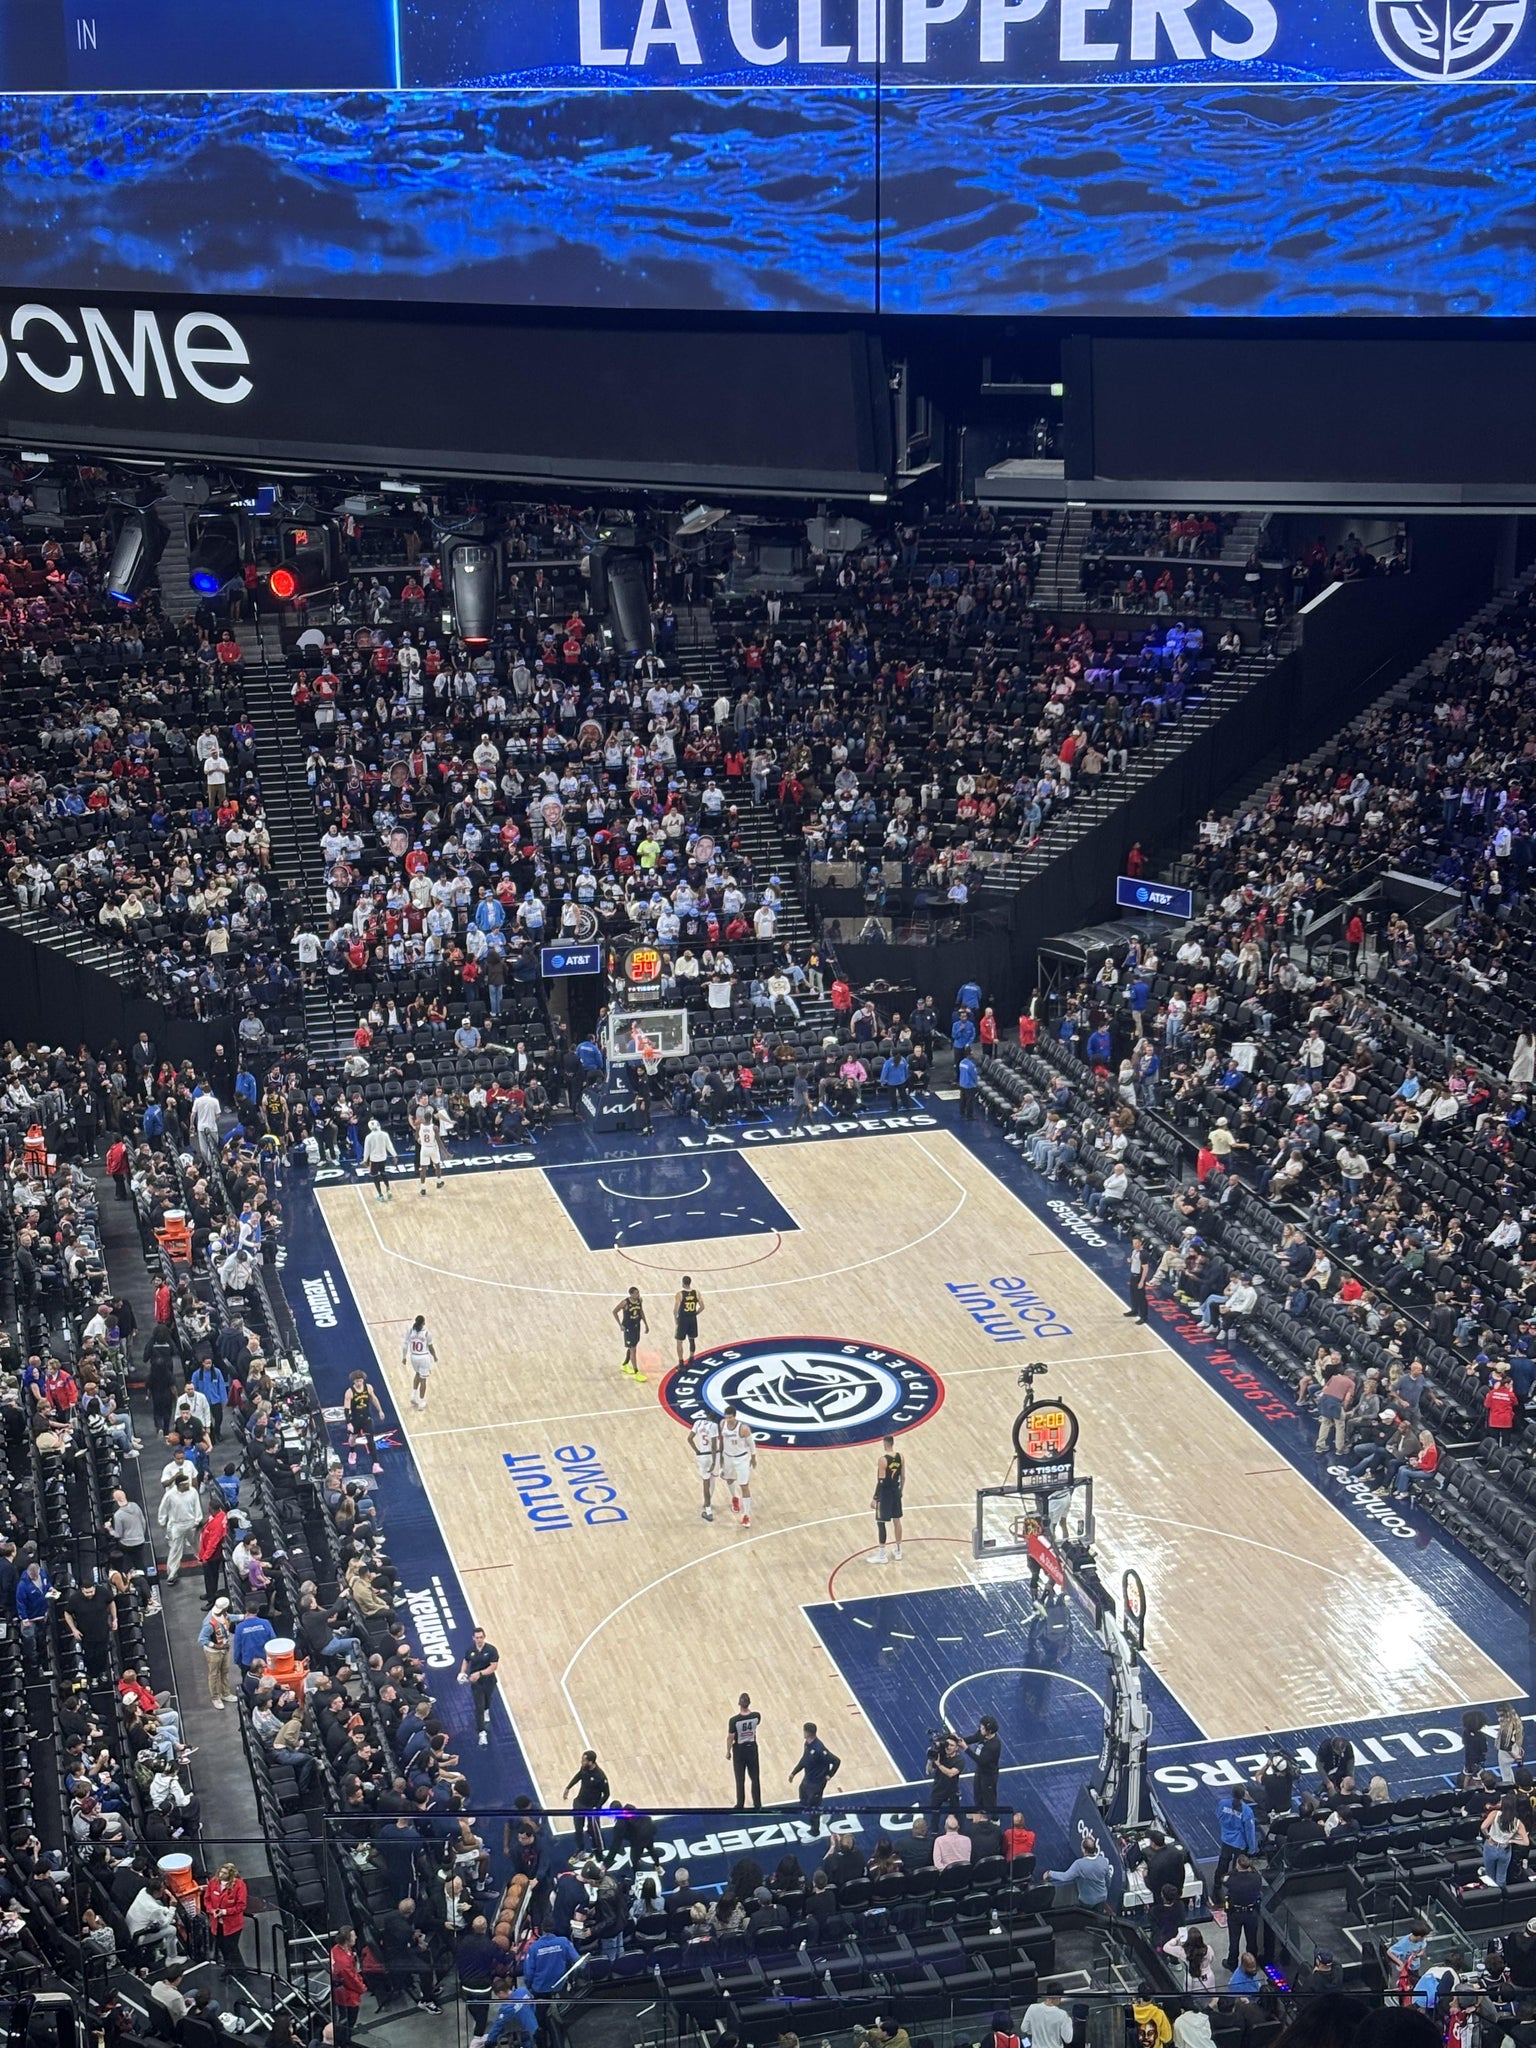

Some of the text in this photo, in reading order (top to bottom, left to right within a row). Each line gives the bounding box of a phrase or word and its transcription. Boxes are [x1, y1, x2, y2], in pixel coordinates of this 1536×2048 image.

[76, 18, 97, 51] IN
[578, 0, 1279, 66] LA CLIPPERS
[1149, 892, 1173, 905] AT&T
[566, 954, 591, 966] AT&T
[633, 951, 657, 963] 12:00
[631, 962, 656, 981] 24
[678, 1133, 735, 1149] LA
[1046, 1200, 1107, 1247] coinbase
[684, 1301, 696, 1312] 30
[411, 1340, 424, 1353] 10
[675, 1350, 742, 1420] ANGELES
[841, 1345, 929, 1423] CLIPPERS
[1031, 1412, 1065, 1430] 12:00
[702, 1434, 709, 1446] 5
[890, 1468, 898, 1480] 7
[1036, 1464, 1071, 1475] TISSOT
[1326, 1465, 1417, 1538] coinbase
[742, 1721, 753, 1731] 64
